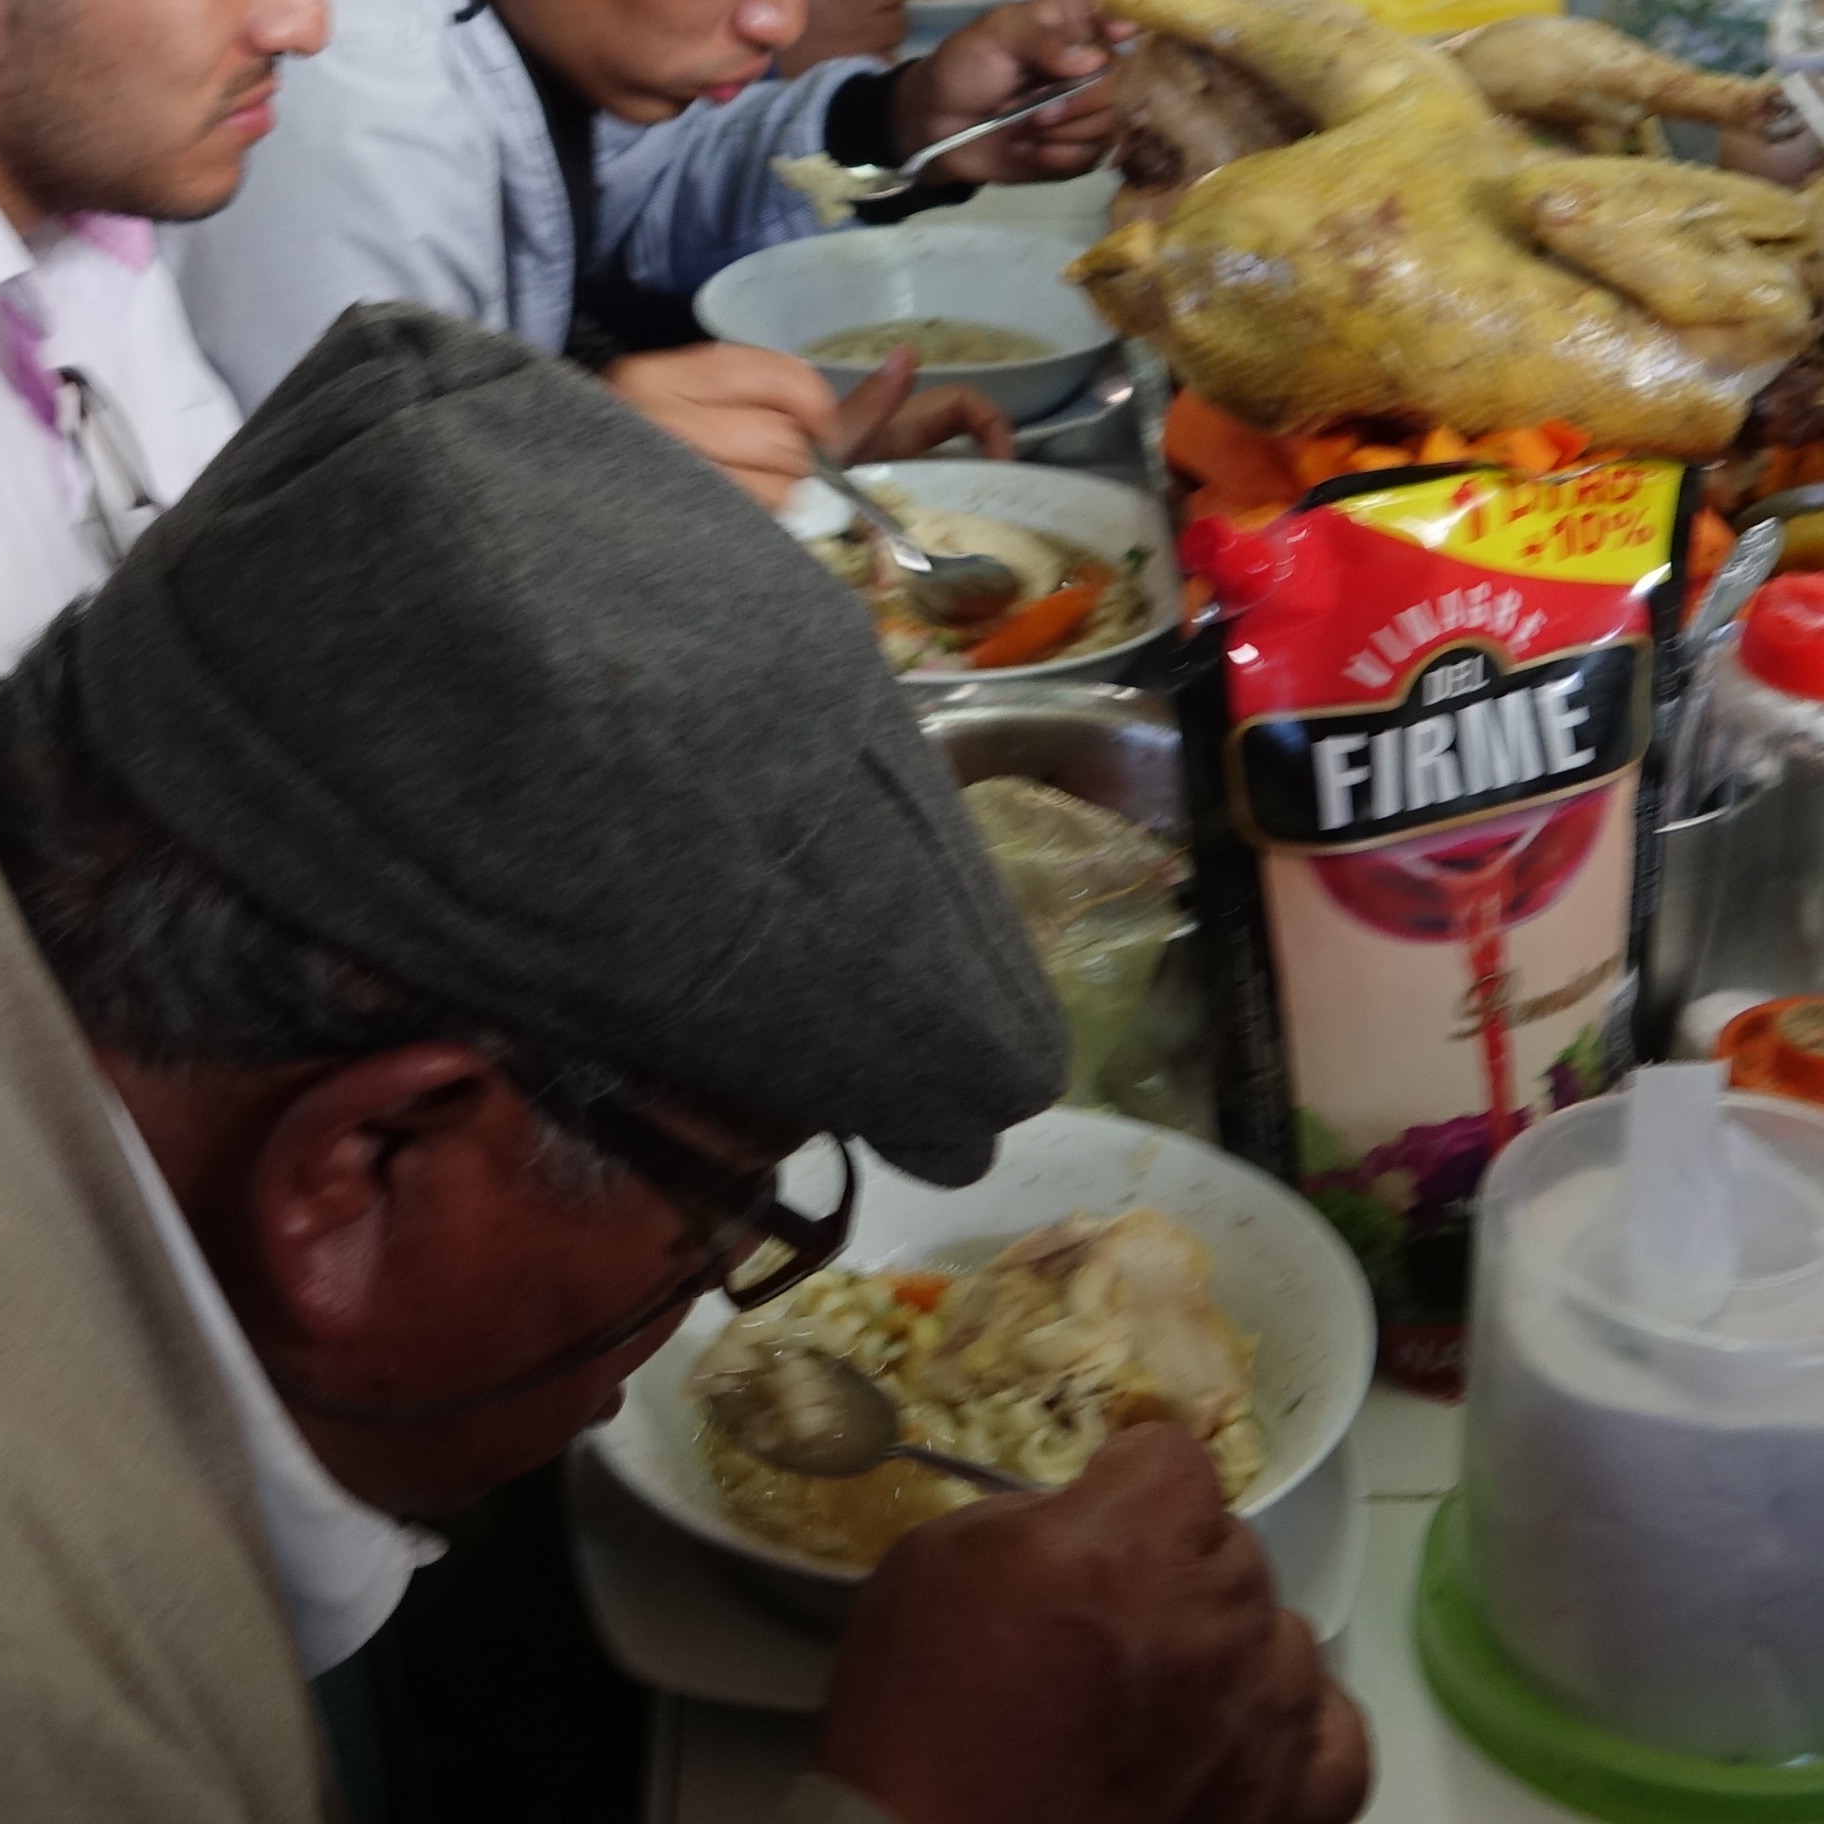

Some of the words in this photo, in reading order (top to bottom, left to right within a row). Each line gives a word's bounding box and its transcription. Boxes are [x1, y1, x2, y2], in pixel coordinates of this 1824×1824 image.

[1341, 582, 1548, 688] VINAGRE
[1421, 652, 1492, 708] DEL
[1310, 671, 1598, 832] FIRME
